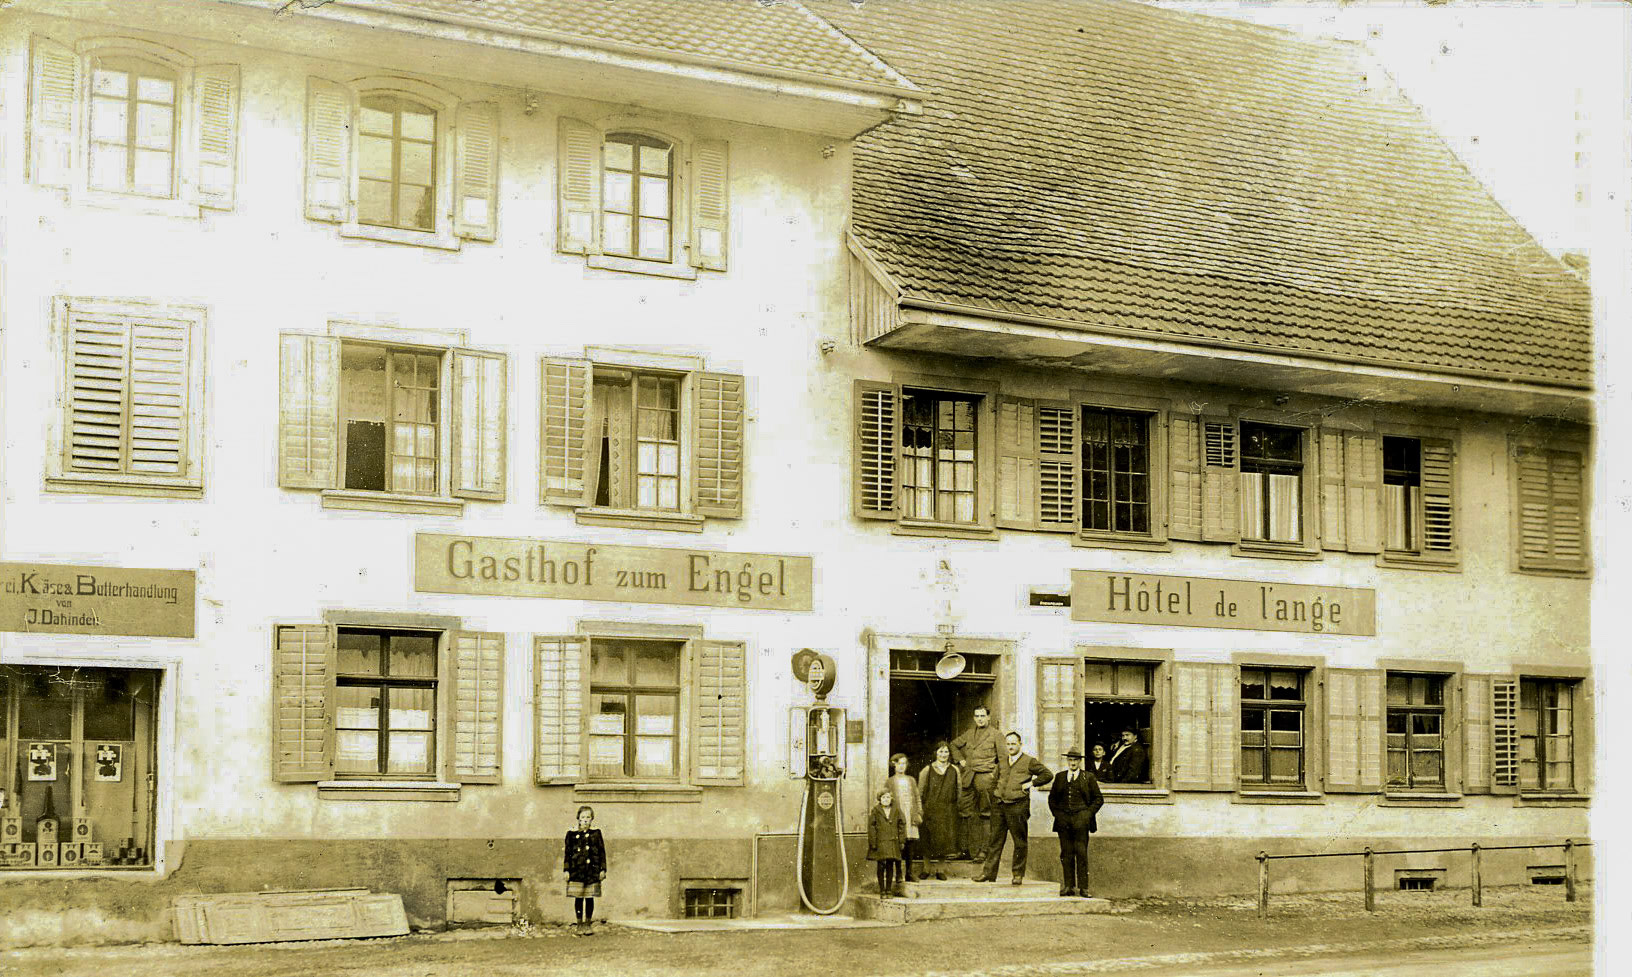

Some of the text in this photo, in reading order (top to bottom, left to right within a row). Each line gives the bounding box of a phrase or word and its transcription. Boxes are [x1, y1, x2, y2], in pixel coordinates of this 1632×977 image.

[76, 574, 178, 604] Butterhandlung
[448, 540, 786, 602] Gasthof zum Engel
[56, 600, 72, 608] von
[1107, 576, 1342, 632] Hôtel de l'ange
